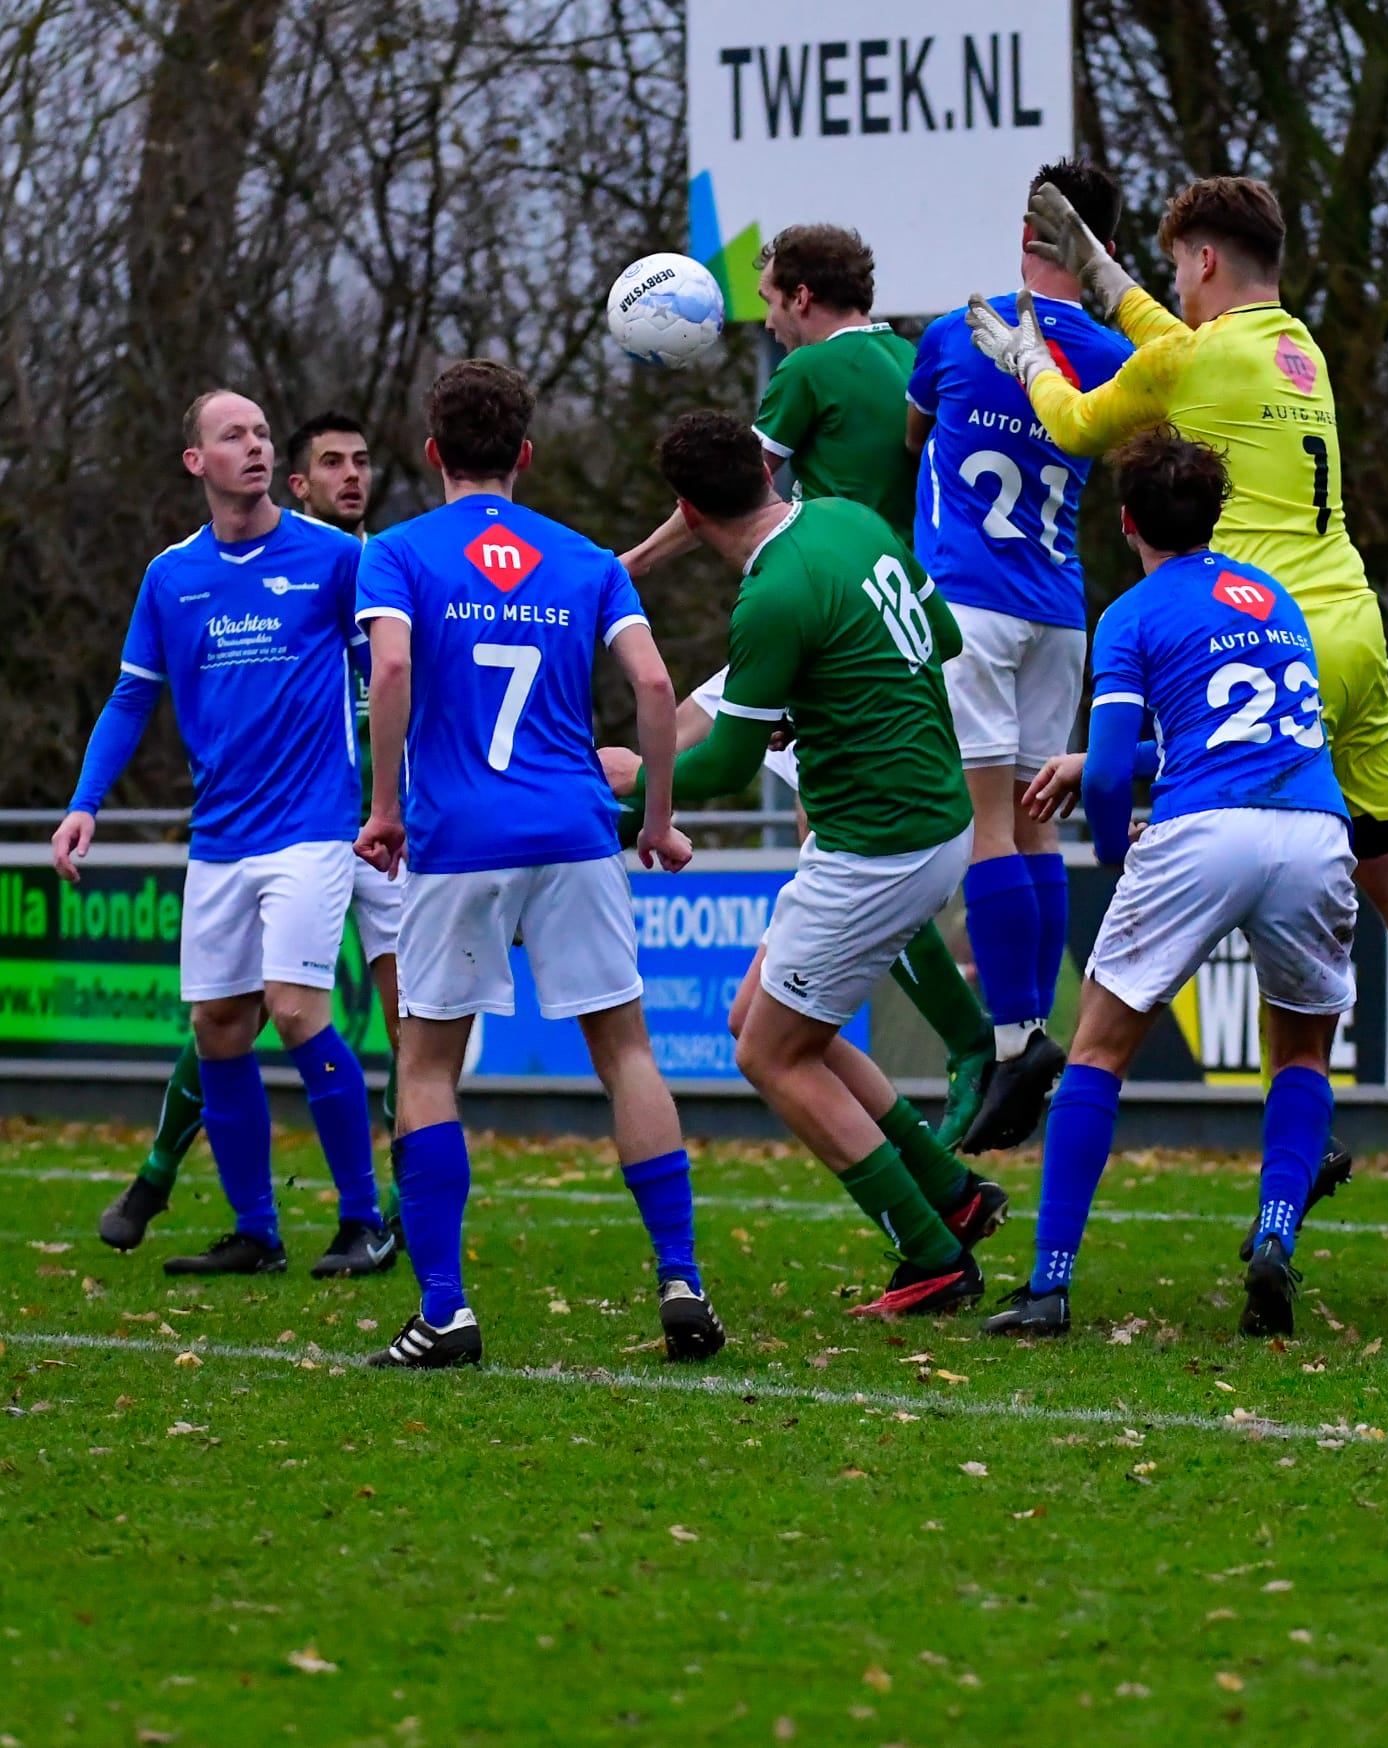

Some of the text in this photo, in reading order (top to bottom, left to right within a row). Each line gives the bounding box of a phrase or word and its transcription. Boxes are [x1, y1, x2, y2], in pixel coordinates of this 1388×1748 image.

[719, 32, 1042, 141] TWEEK.NL
[620, 268, 676, 313] DERBYSTAR
[968, 409, 1022, 434] AUTO
[958, 450, 1069, 565] 21
[1303, 435, 1332, 535] 1
[482, 543, 521, 569] m
[445, 602, 570, 626] AUTO MELSE
[861, 554, 933, 675] 18
[1224, 585, 1265, 604] m
[205, 613, 282, 637] Wachters
[1209, 631, 1260, 653] AUTO
[472, 643, 542, 771] 7
[1206, 661, 1324, 750] 23
